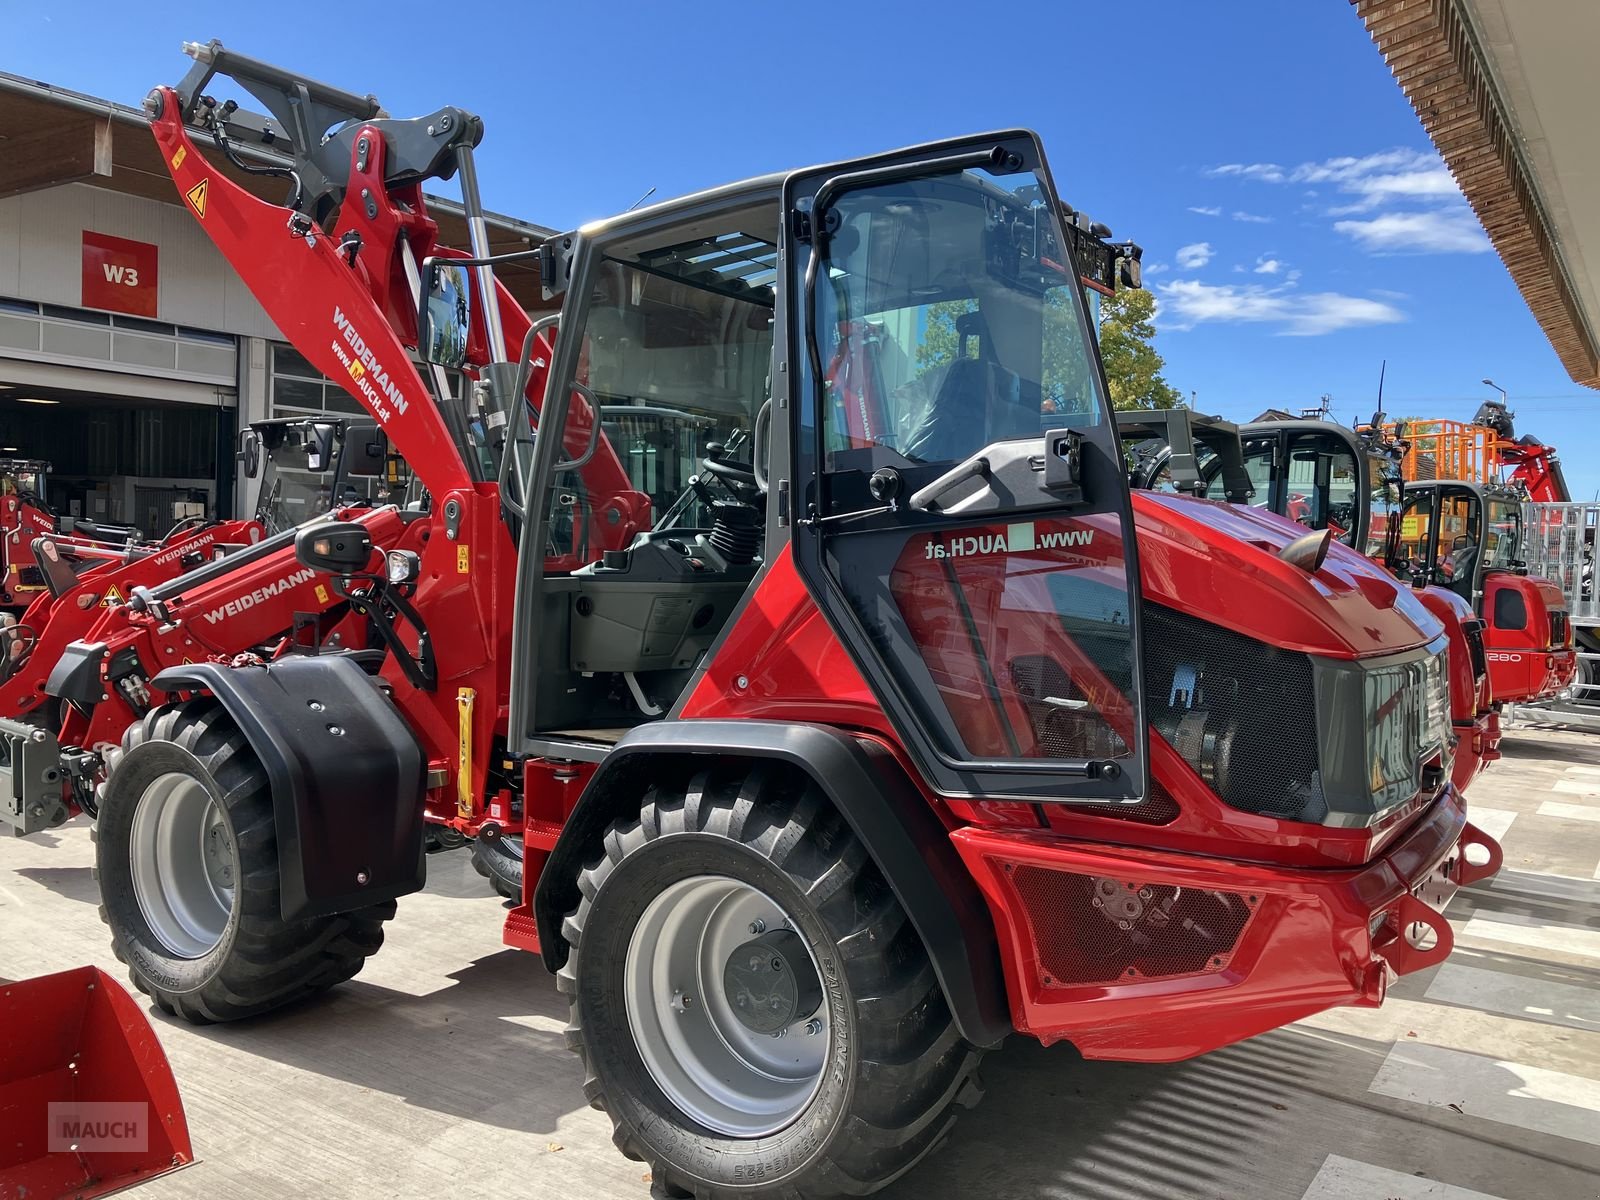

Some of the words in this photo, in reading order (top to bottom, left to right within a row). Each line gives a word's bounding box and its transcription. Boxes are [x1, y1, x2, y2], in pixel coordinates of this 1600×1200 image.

[102, 263, 139, 287] W3
[331, 340, 391, 423] www.MAUCH.at
[333, 305, 409, 416] WEIDEMANN
[153, 533, 215, 566] WEIDEMANN
[202, 568, 316, 625] WEIDEMANN
